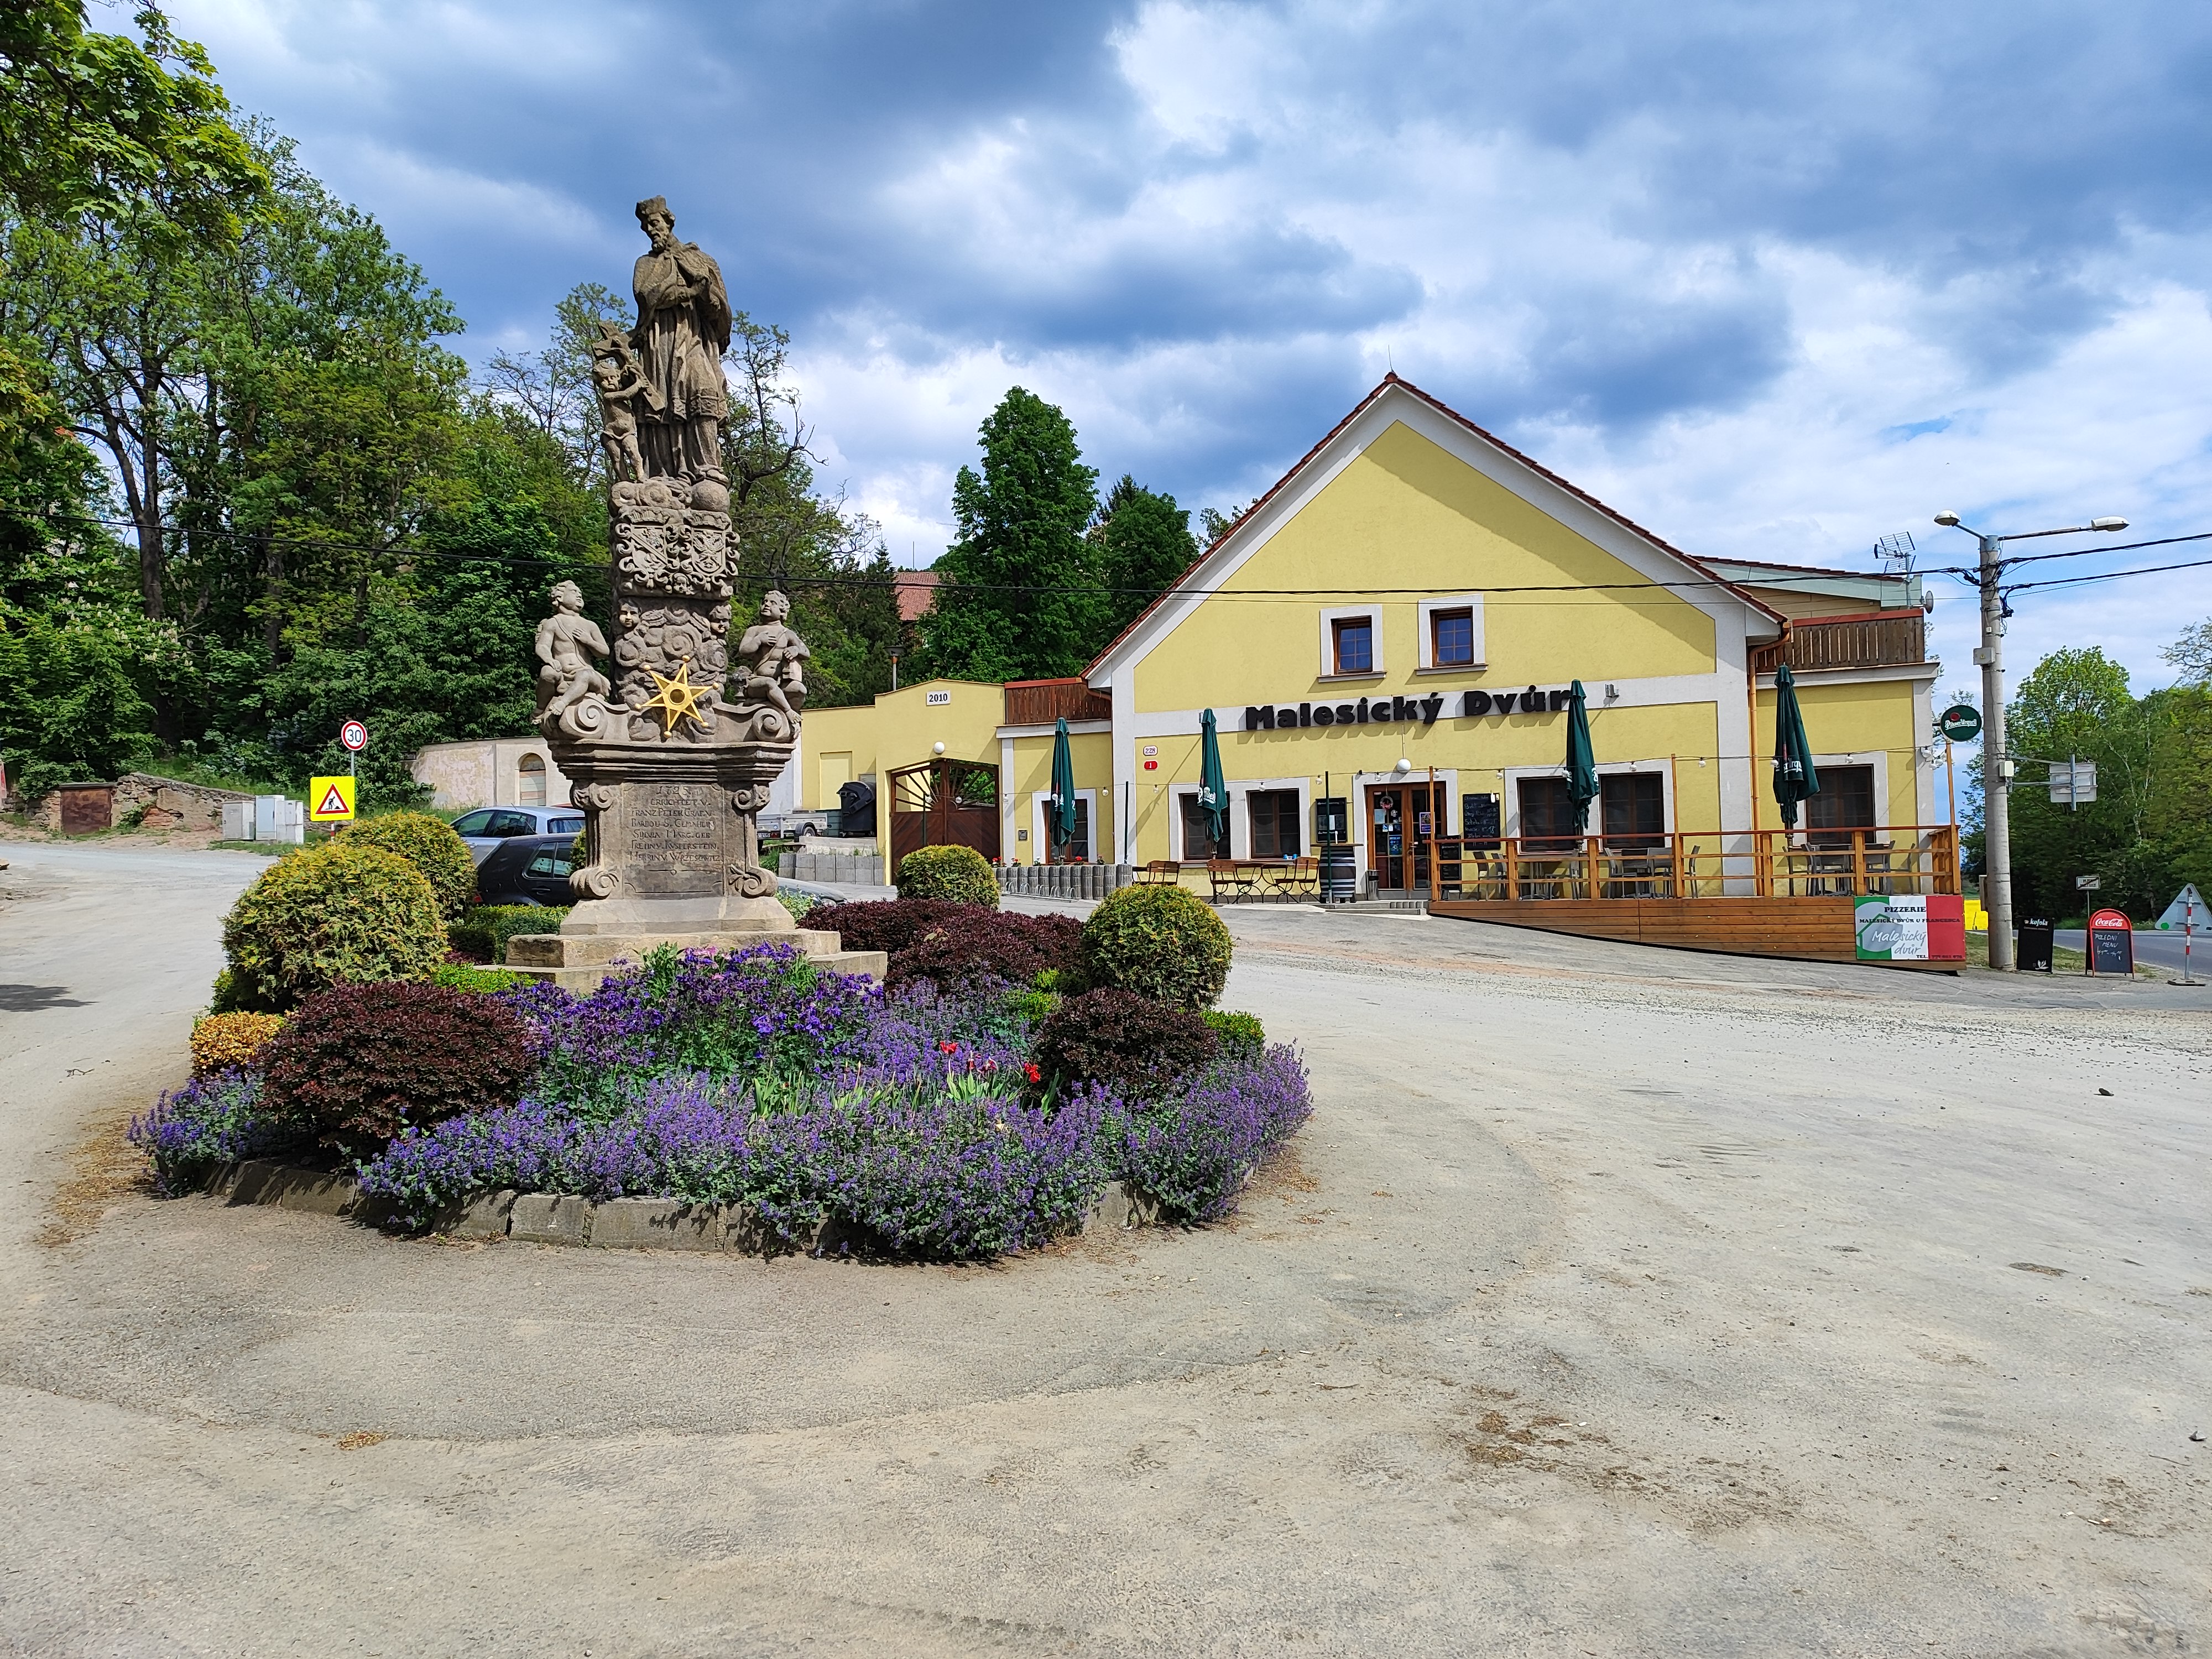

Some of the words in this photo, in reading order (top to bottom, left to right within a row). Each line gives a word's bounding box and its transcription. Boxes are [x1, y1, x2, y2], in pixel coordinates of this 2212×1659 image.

[929, 693, 948, 702] 2010
[1245, 692, 1444, 730] Malesický
[1464, 685, 1571, 716] Dvůr
[1944, 719, 1961, 730] Pilsner
[1960, 718, 1977, 727] Urquell
[347, 729, 362, 743] 30
[631, 807, 657, 817] FRANZ
[658, 807, 684, 817] PETER
[1871, 930, 1927, 946] Malesický
[1894, 943, 1921, 954] dvůr
